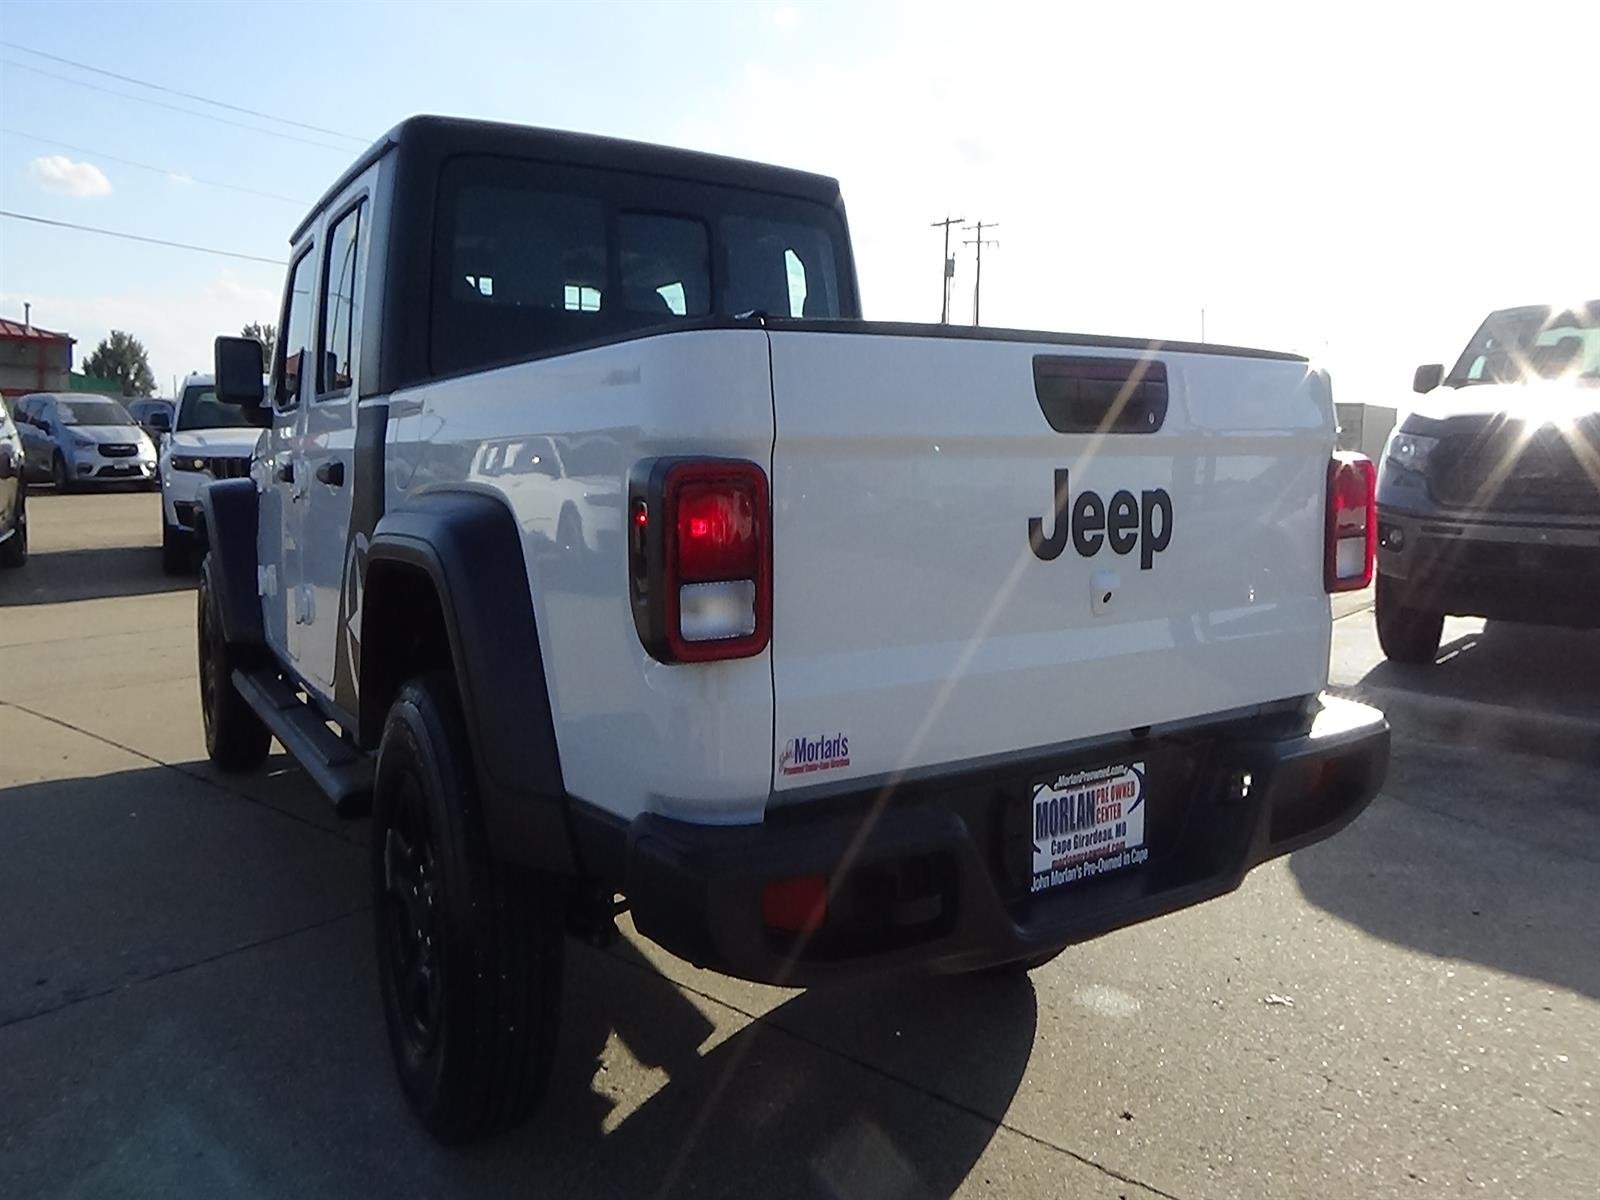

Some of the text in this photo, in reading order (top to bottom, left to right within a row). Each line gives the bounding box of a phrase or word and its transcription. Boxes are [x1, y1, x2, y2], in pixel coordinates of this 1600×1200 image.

[1028, 468, 1173, 570] Jeep
[1096, 781, 1135, 805] PRE OWNED
[1035, 790, 1095, 841] MORLAN
[1096, 803, 1121, 824] CENTER
[1051, 837, 1072, 855] Cape
[1115, 821, 1127, 837] MO
[1031, 875, 1050, 892] John
[1123, 850, 1130, 865] in
[1131, 847, 1149, 865] Cape
